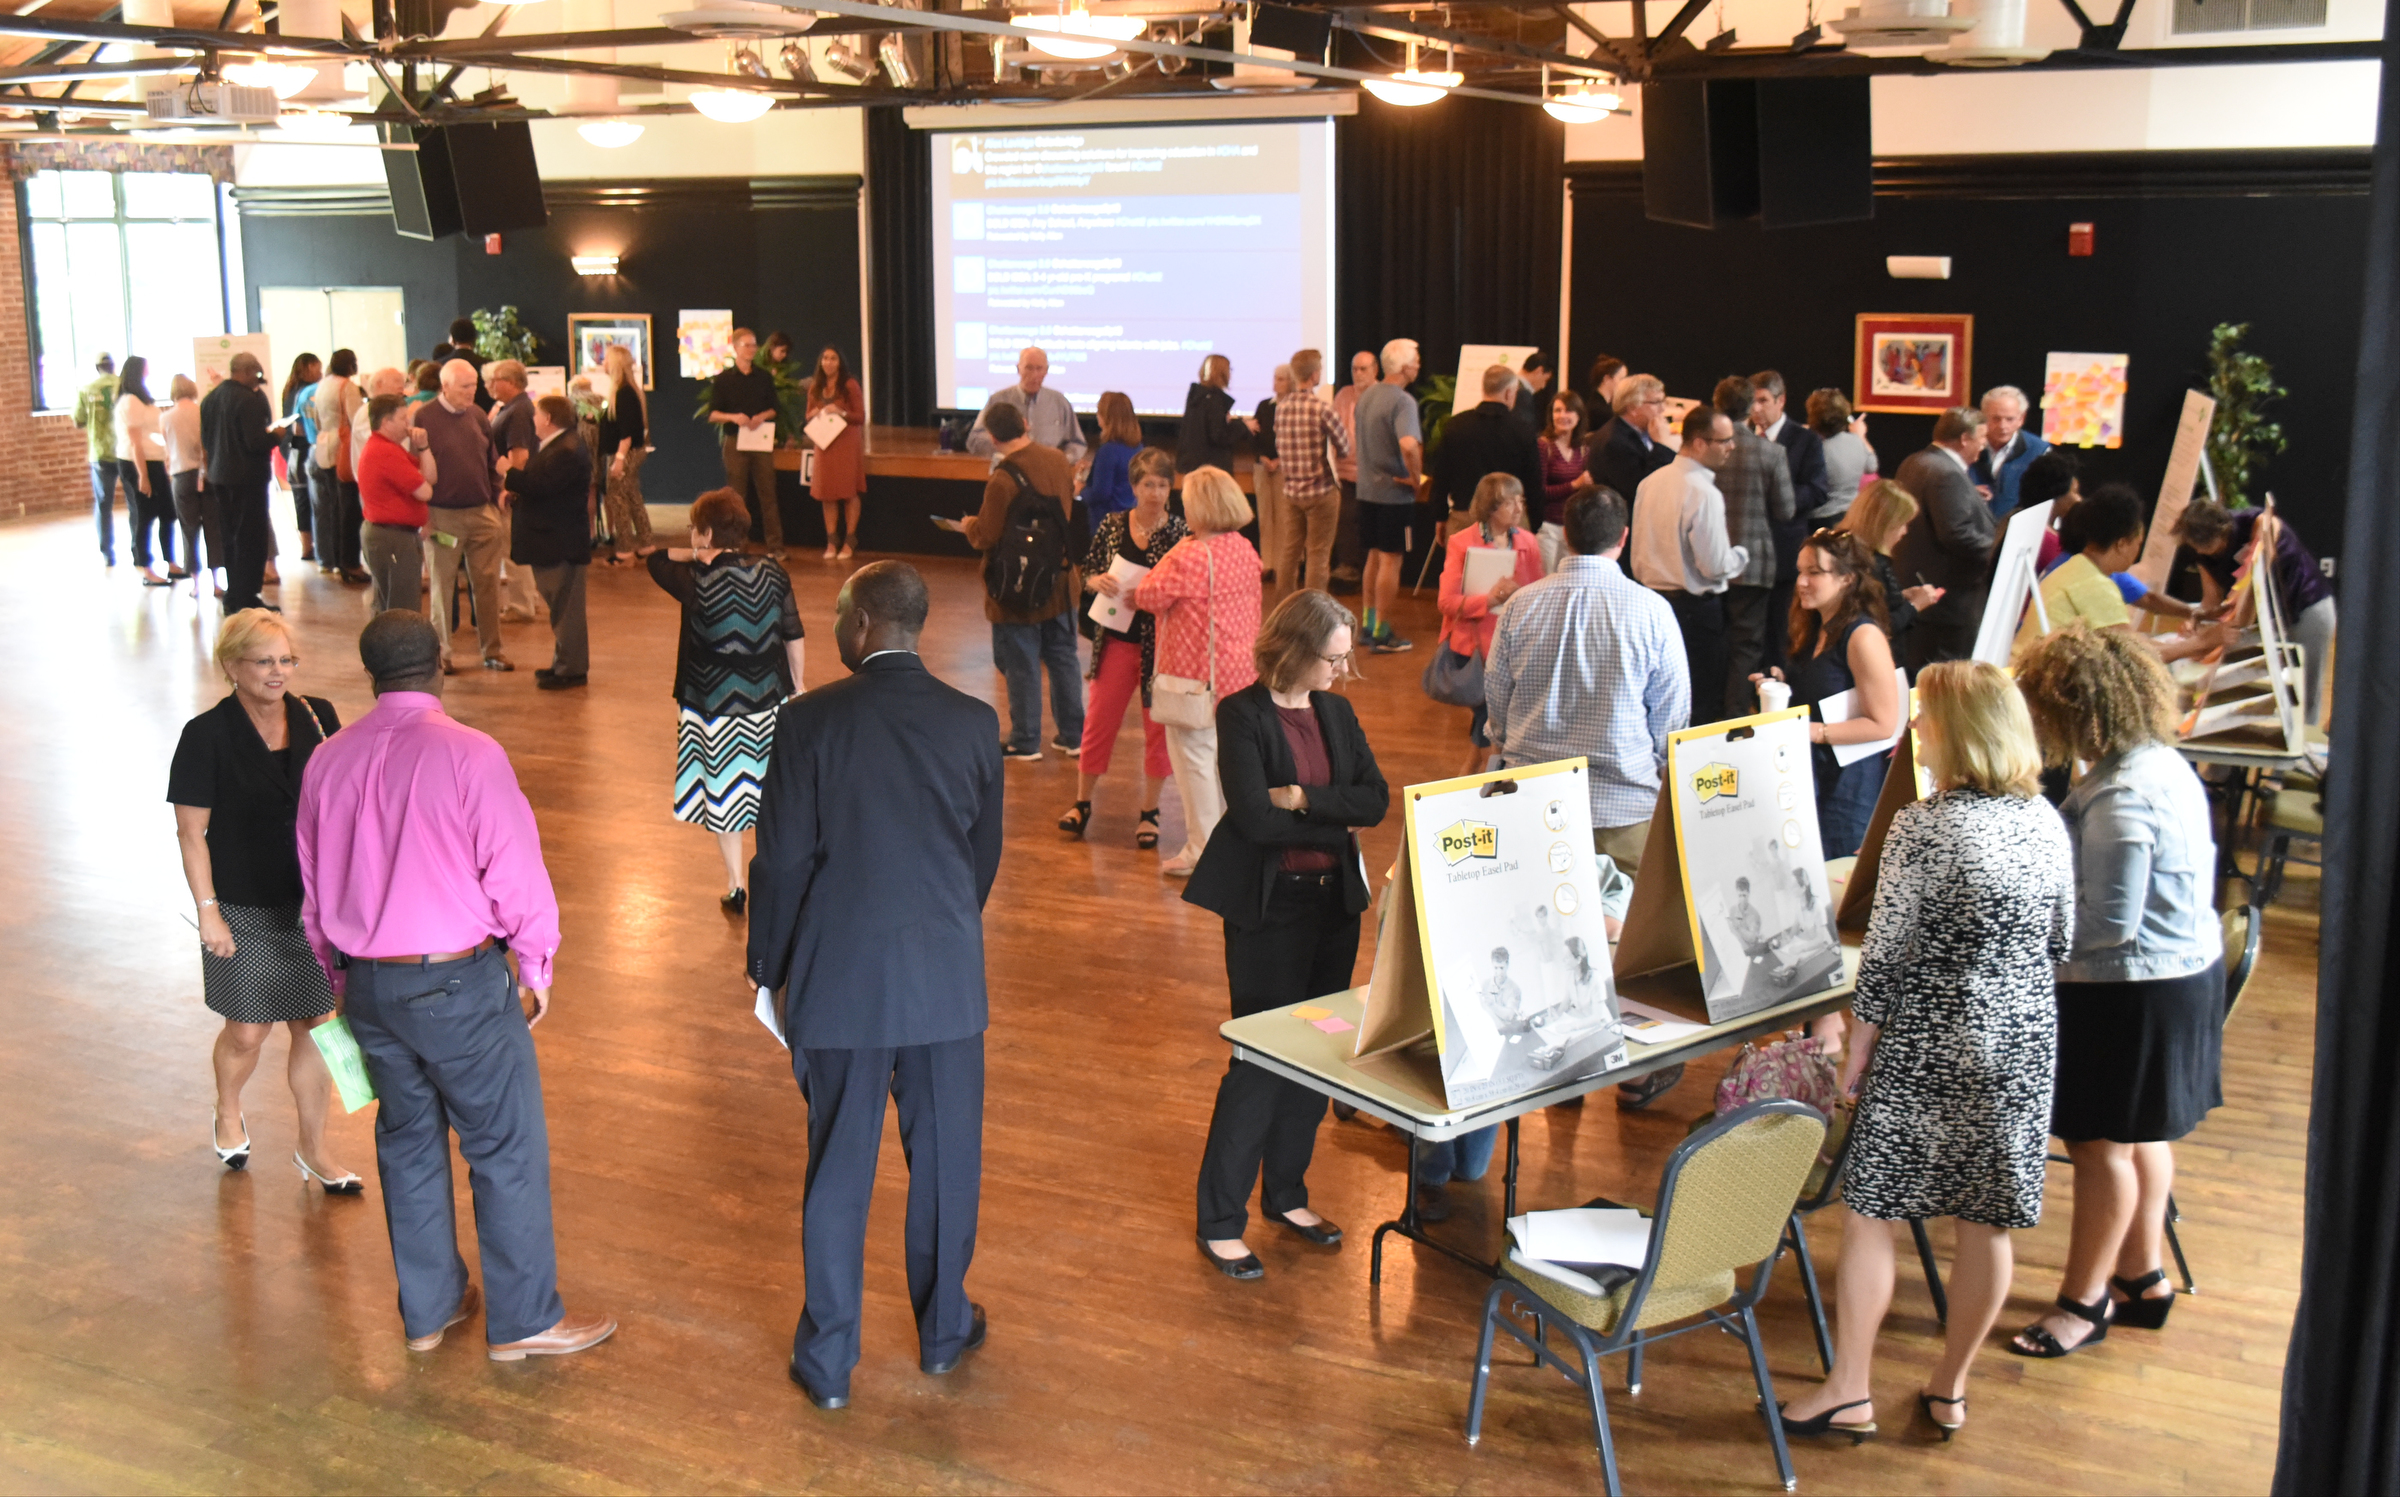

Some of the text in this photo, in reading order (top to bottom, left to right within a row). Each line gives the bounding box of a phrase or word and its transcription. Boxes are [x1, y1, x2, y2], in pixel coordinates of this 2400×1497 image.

[1696, 771, 1735, 791] Post-it
[1442, 829, 1493, 852] Post-it
[1446, 860, 1519, 883] Tabletop Easel Pad
[1610, 1053, 1624, 1063] 3M
